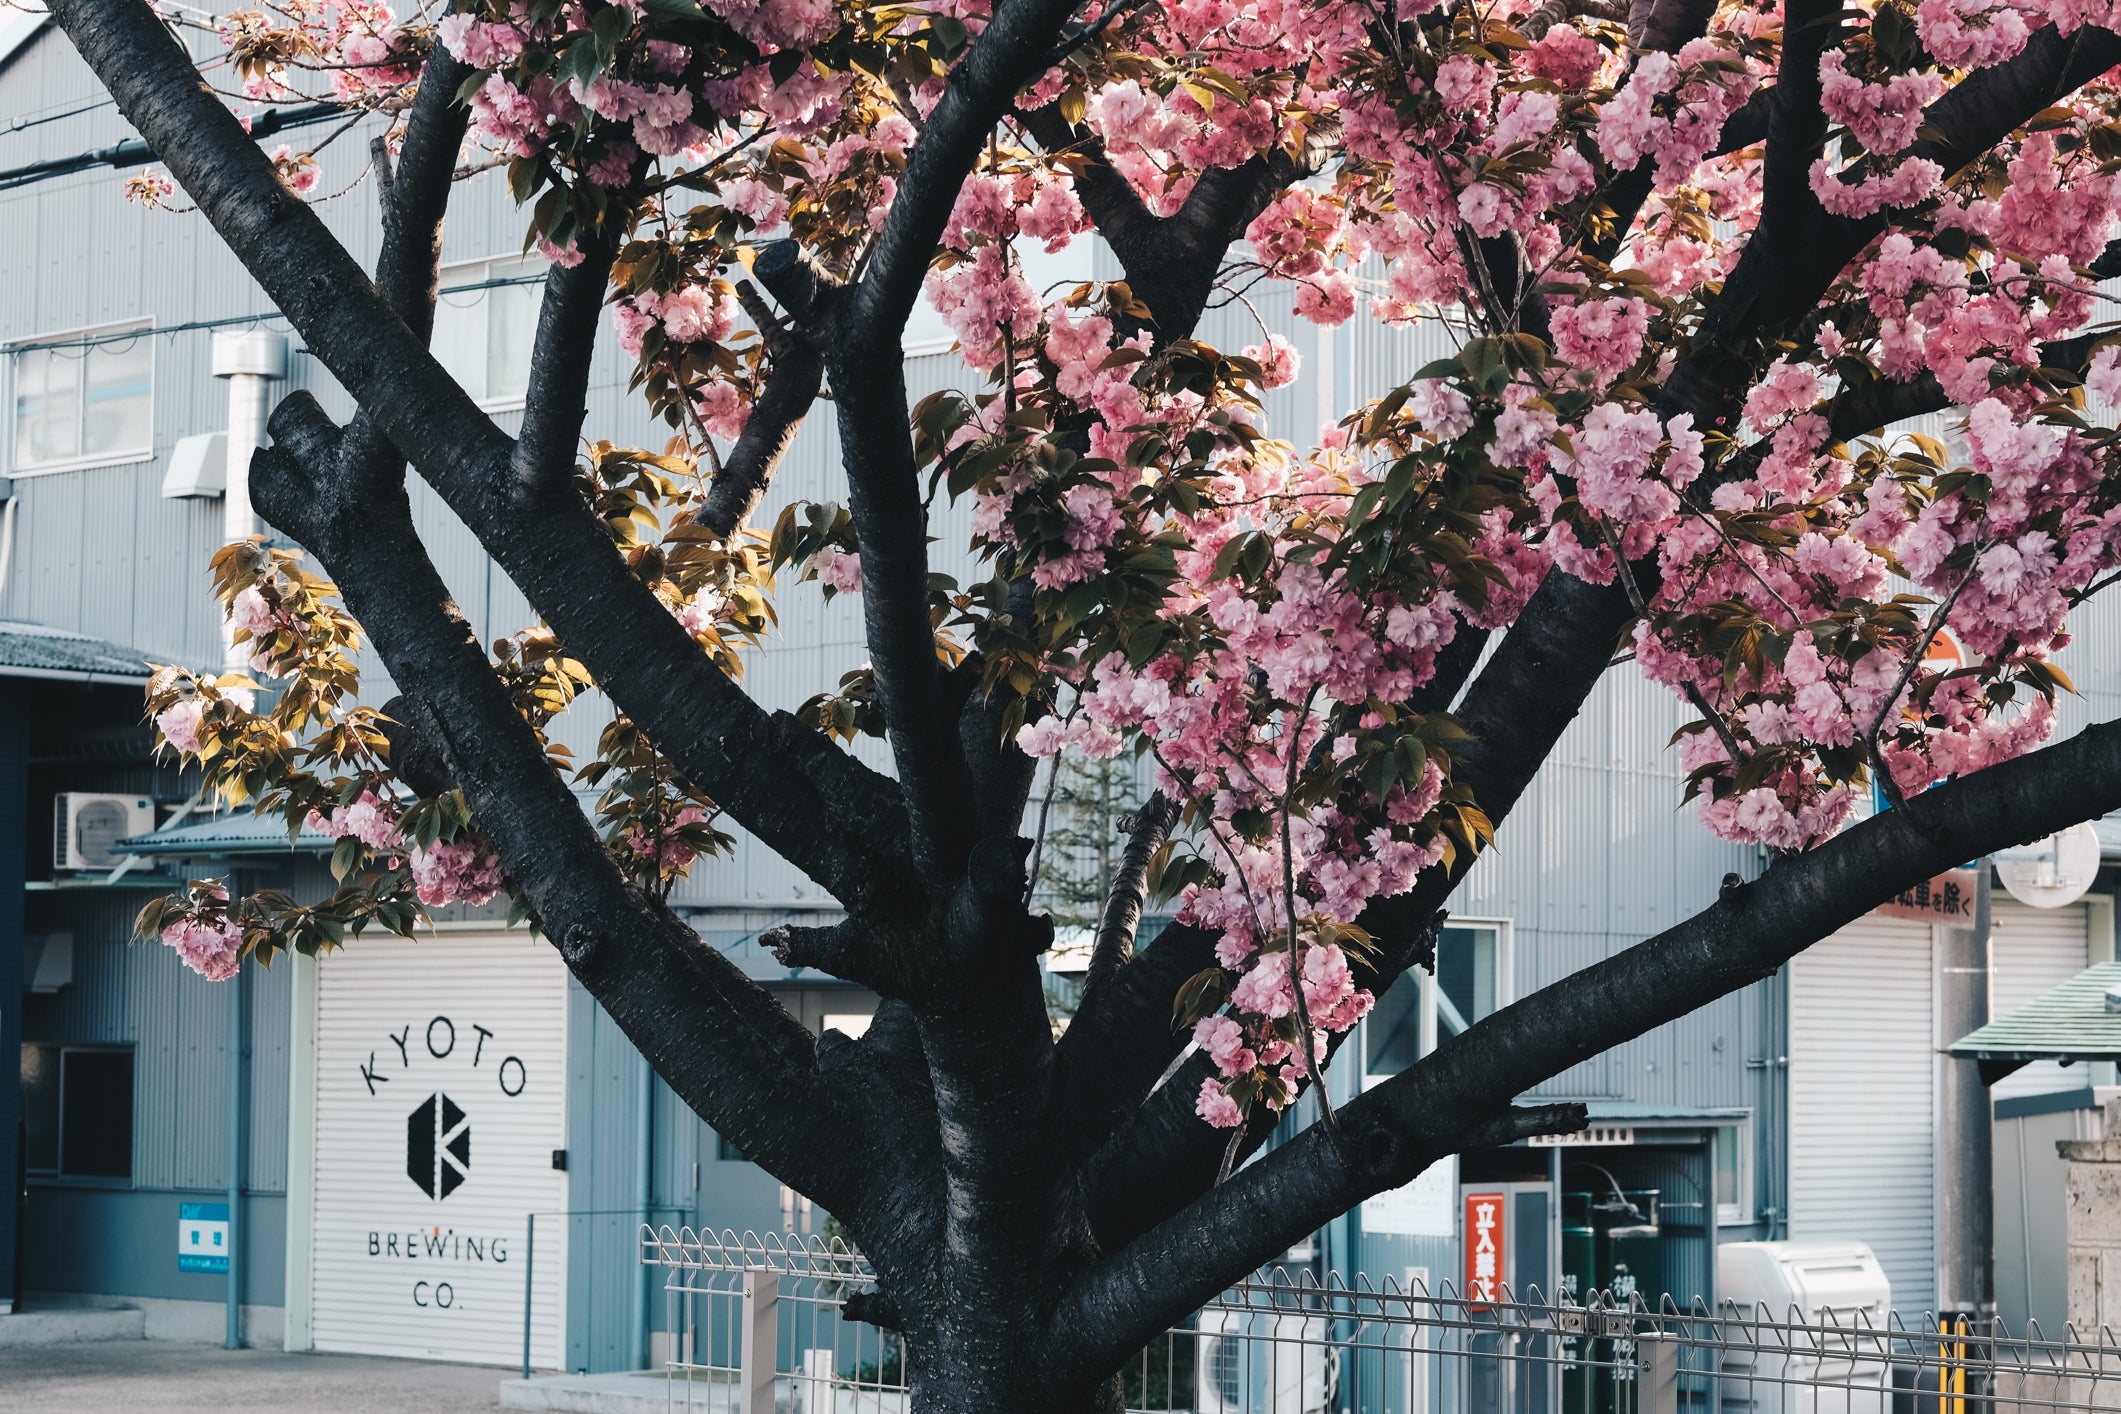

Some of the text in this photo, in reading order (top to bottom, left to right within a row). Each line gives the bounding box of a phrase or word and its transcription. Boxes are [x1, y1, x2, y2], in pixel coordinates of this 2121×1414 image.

[360, 1015, 526, 1097] KYOTO
[369, 1230, 508, 1263] BREWING
[1475, 1202, 1496, 1302] 立入禁止
[413, 1281, 463, 1309] CO.
